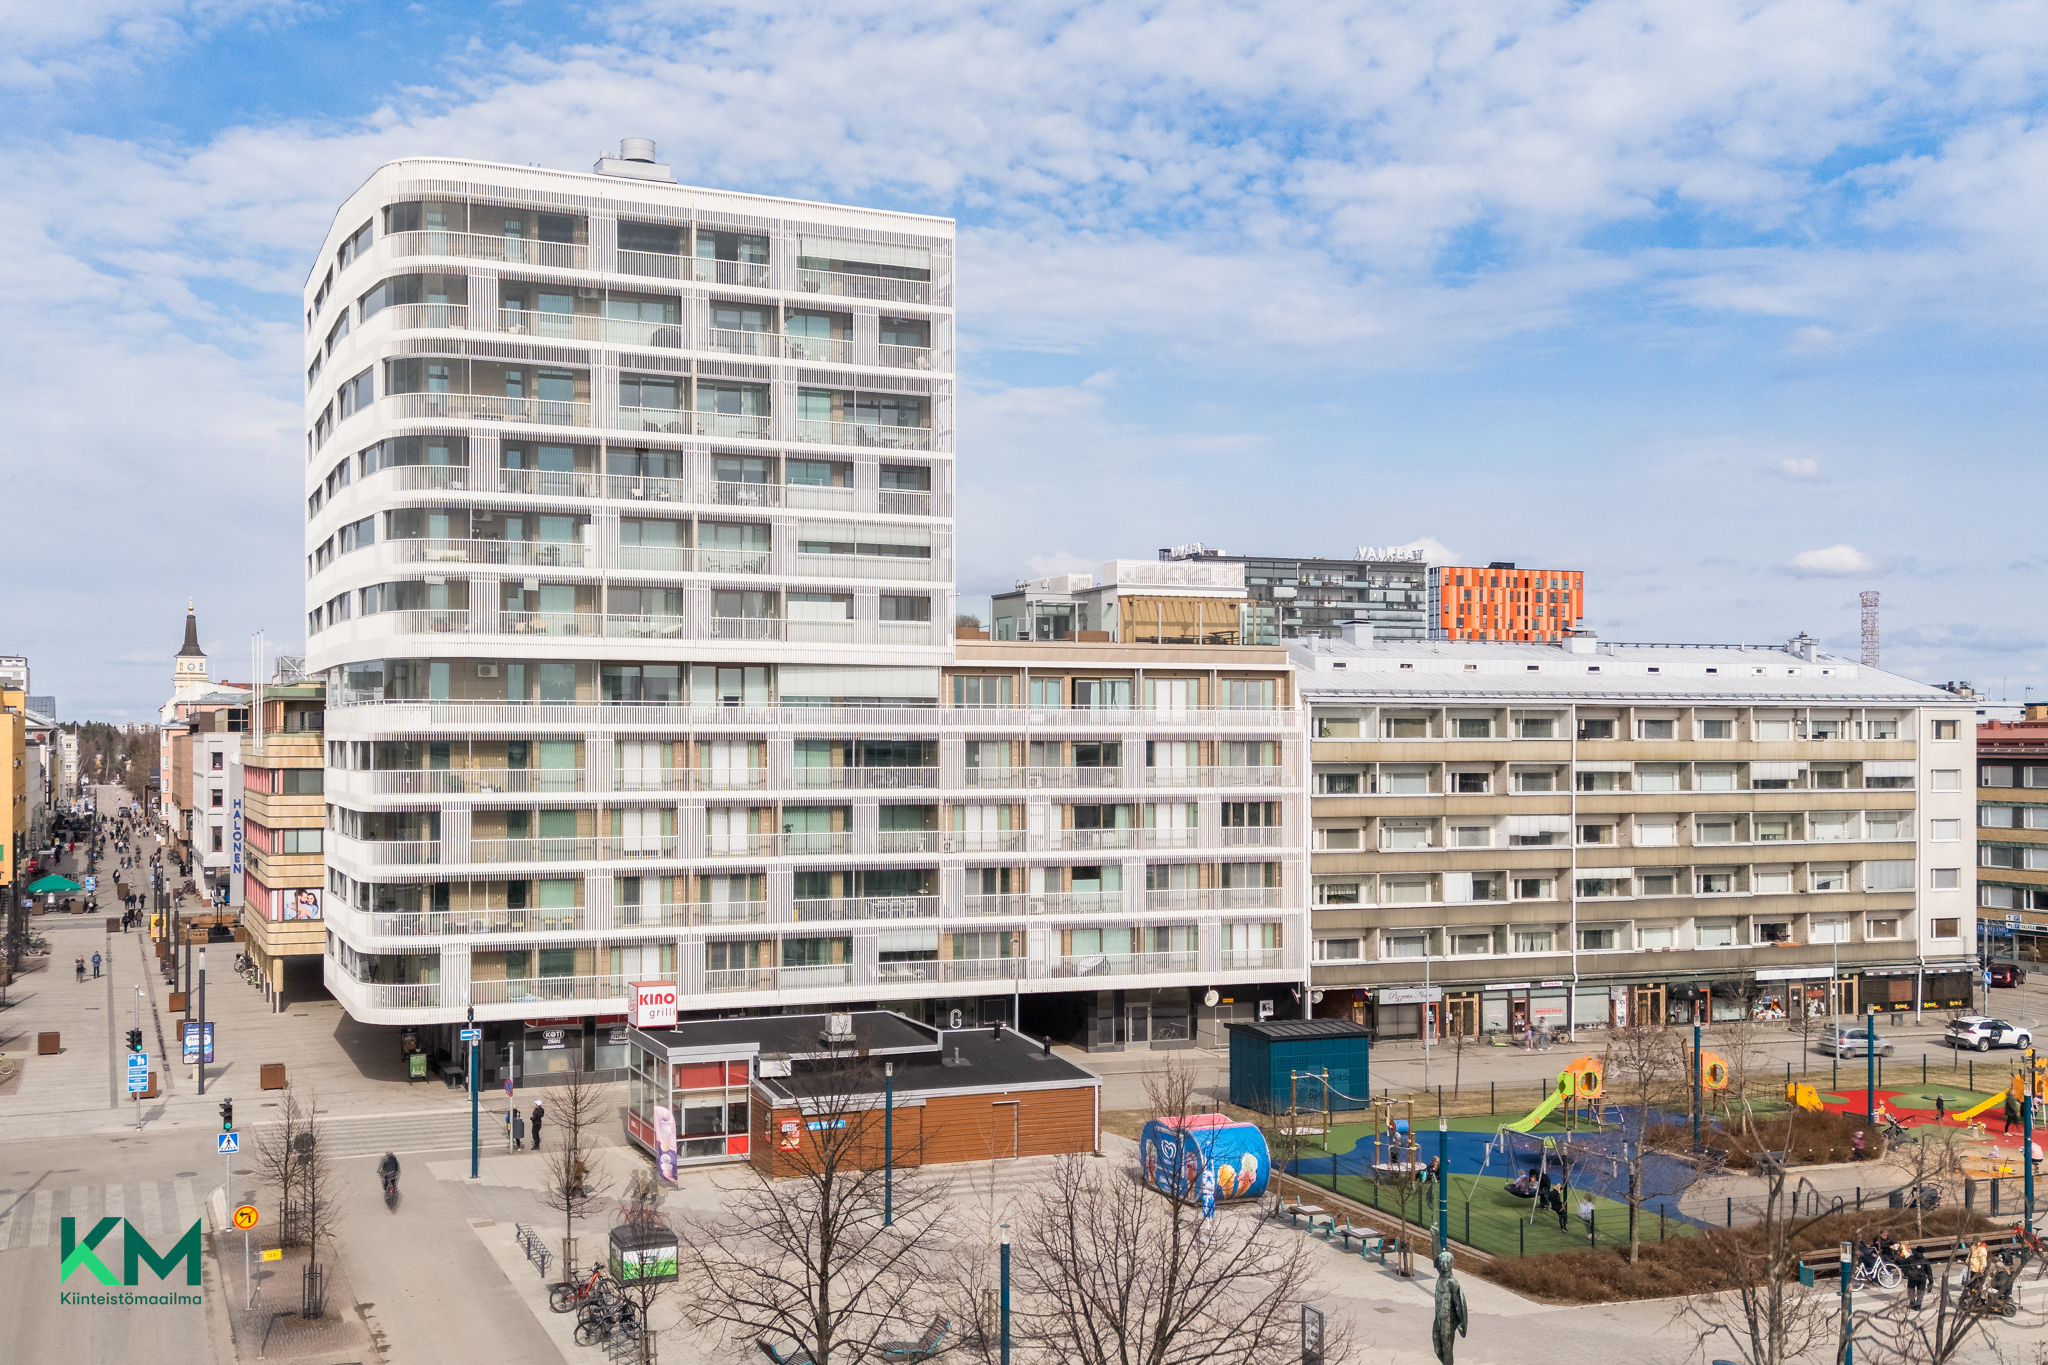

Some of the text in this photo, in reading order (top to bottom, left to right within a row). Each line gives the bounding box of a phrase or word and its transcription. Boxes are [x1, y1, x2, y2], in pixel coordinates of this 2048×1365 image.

[232, 799, 242, 874] HALONEN
[639, 993, 675, 1006] KINO
[649, 1008, 676, 1019] grilli
[950, 1009, 962, 1029] G
